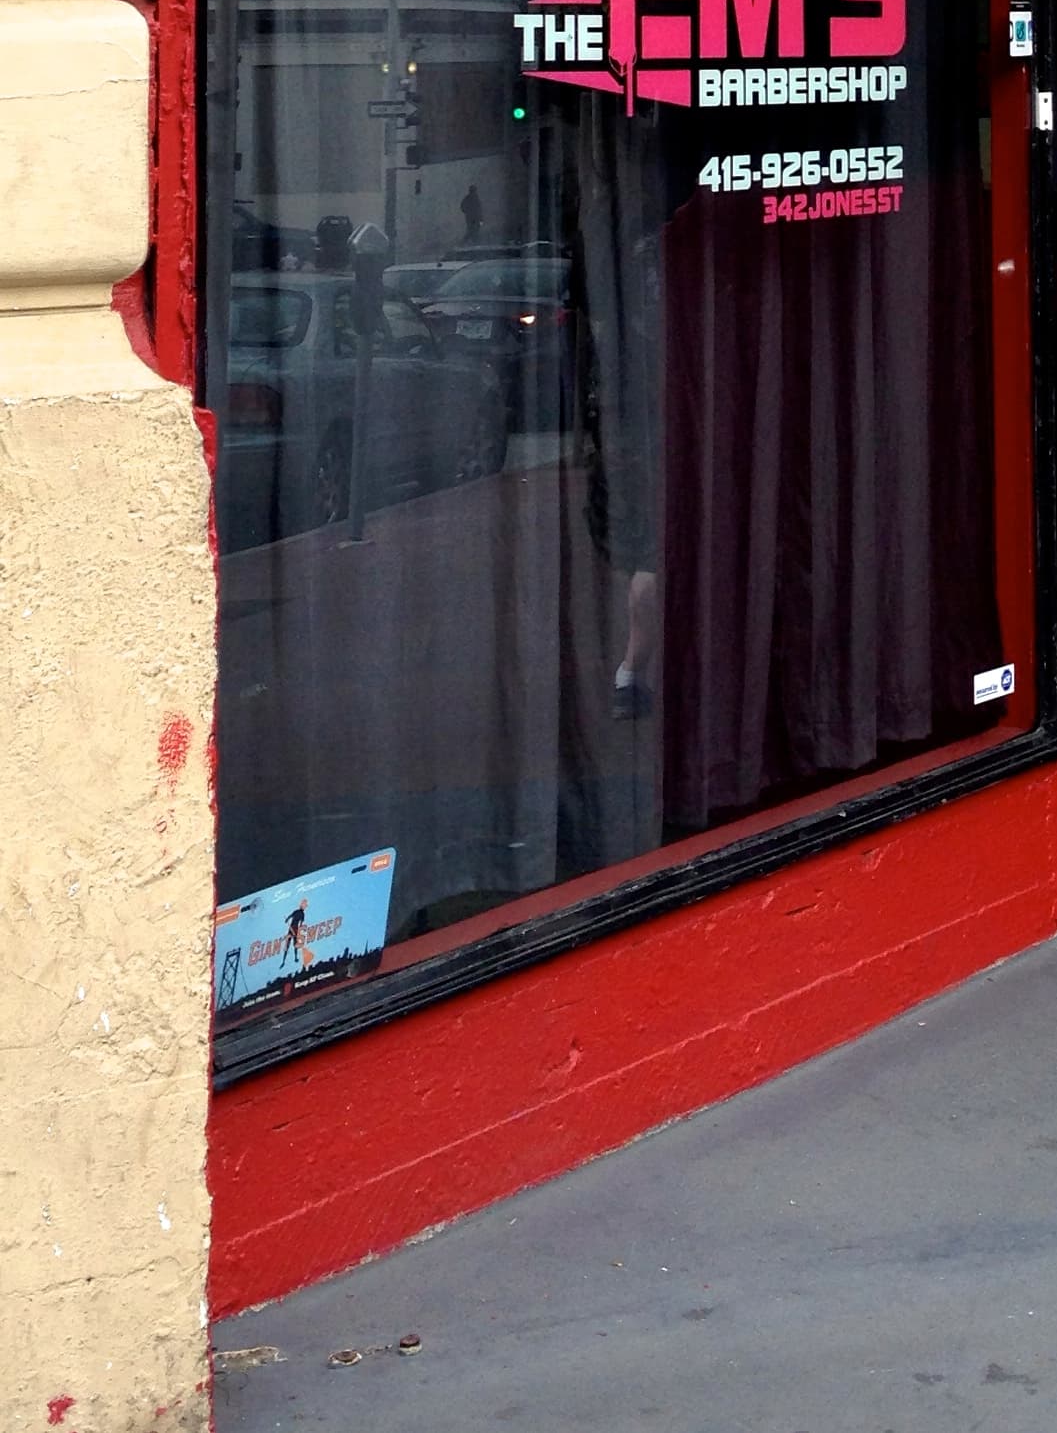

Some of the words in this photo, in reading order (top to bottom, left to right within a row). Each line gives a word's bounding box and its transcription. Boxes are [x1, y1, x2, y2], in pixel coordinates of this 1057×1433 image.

[513, 14, 604, 62] THE
[699, 66, 908, 108] BARBERSHOP
[295, 915, 344, 950] SWEEP
